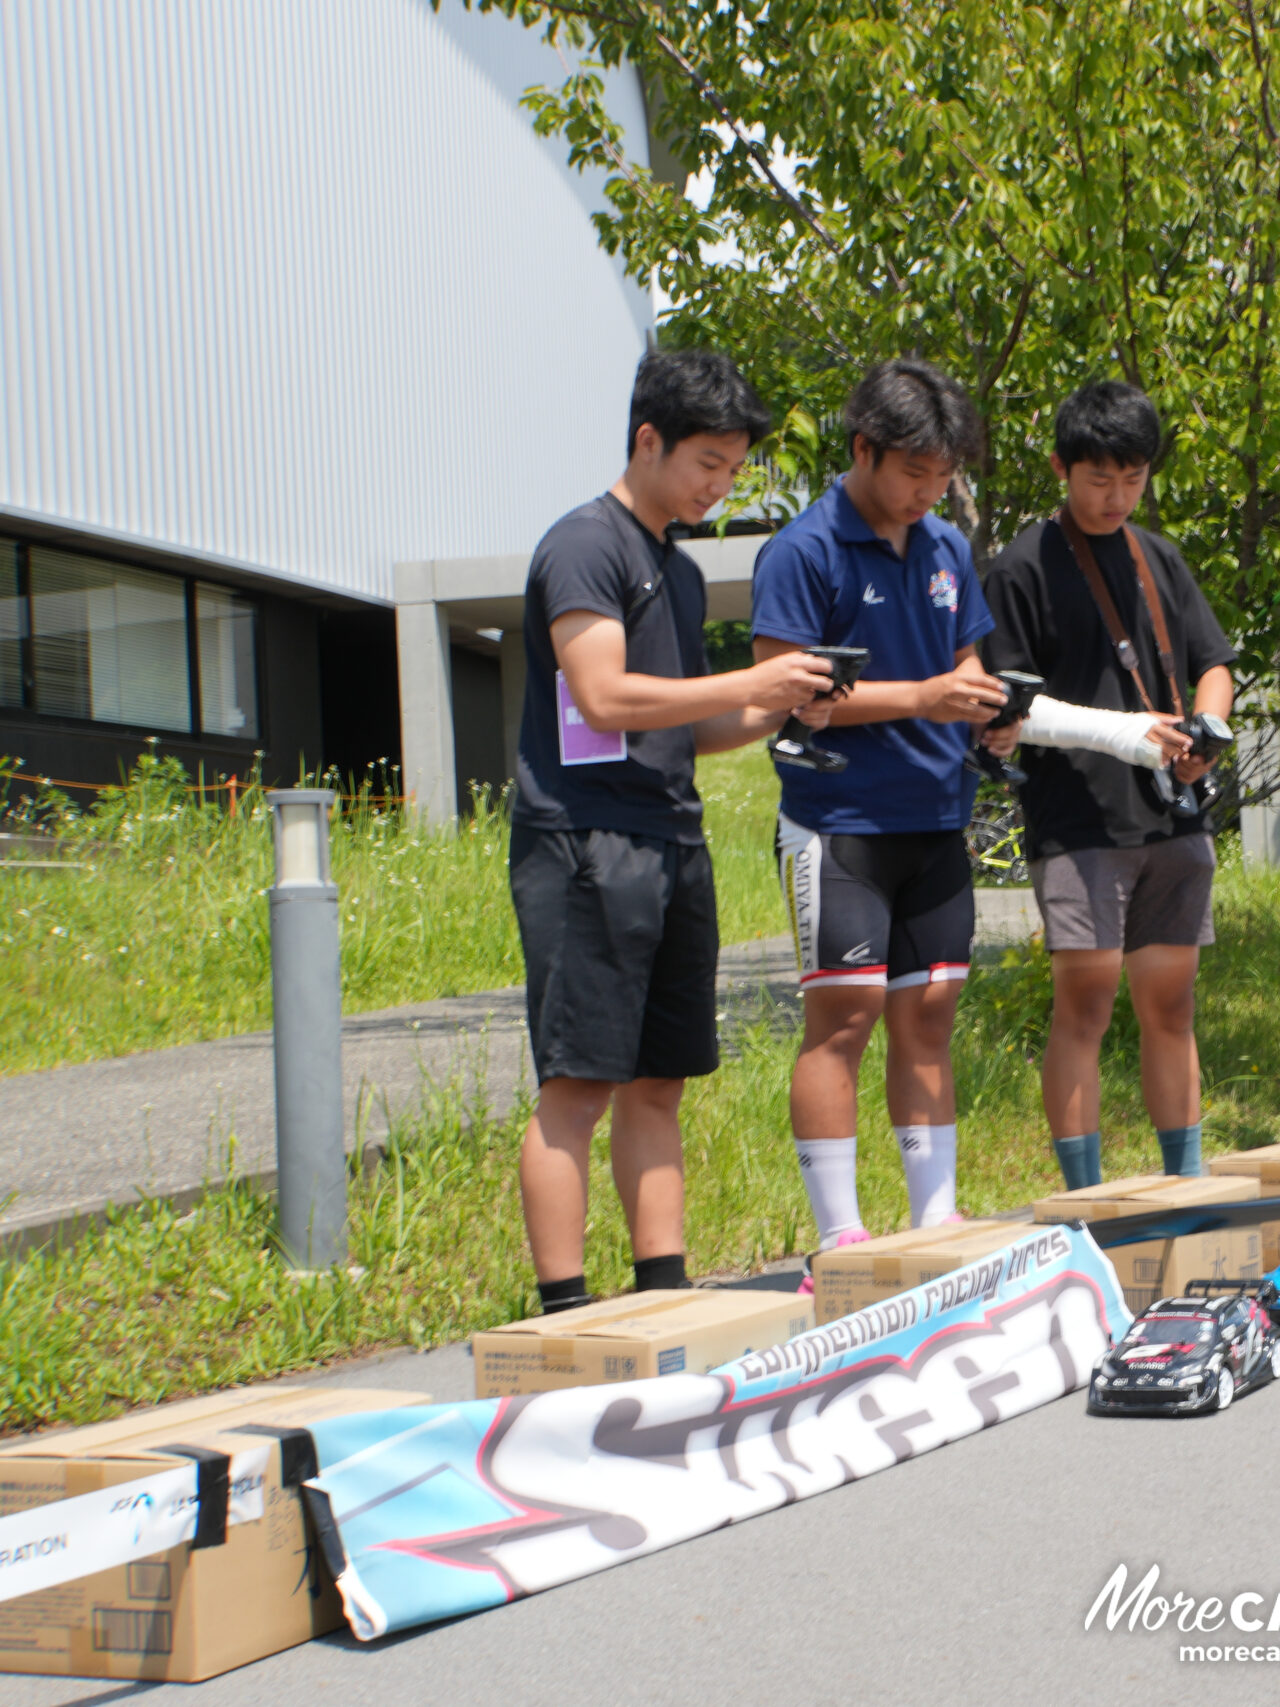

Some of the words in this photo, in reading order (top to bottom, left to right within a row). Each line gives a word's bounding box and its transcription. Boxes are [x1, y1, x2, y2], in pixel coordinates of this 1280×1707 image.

[737, 1295, 920, 1382] competition
[922, 1255, 1004, 1322] racing
[1005, 1227, 1072, 1284] tires
